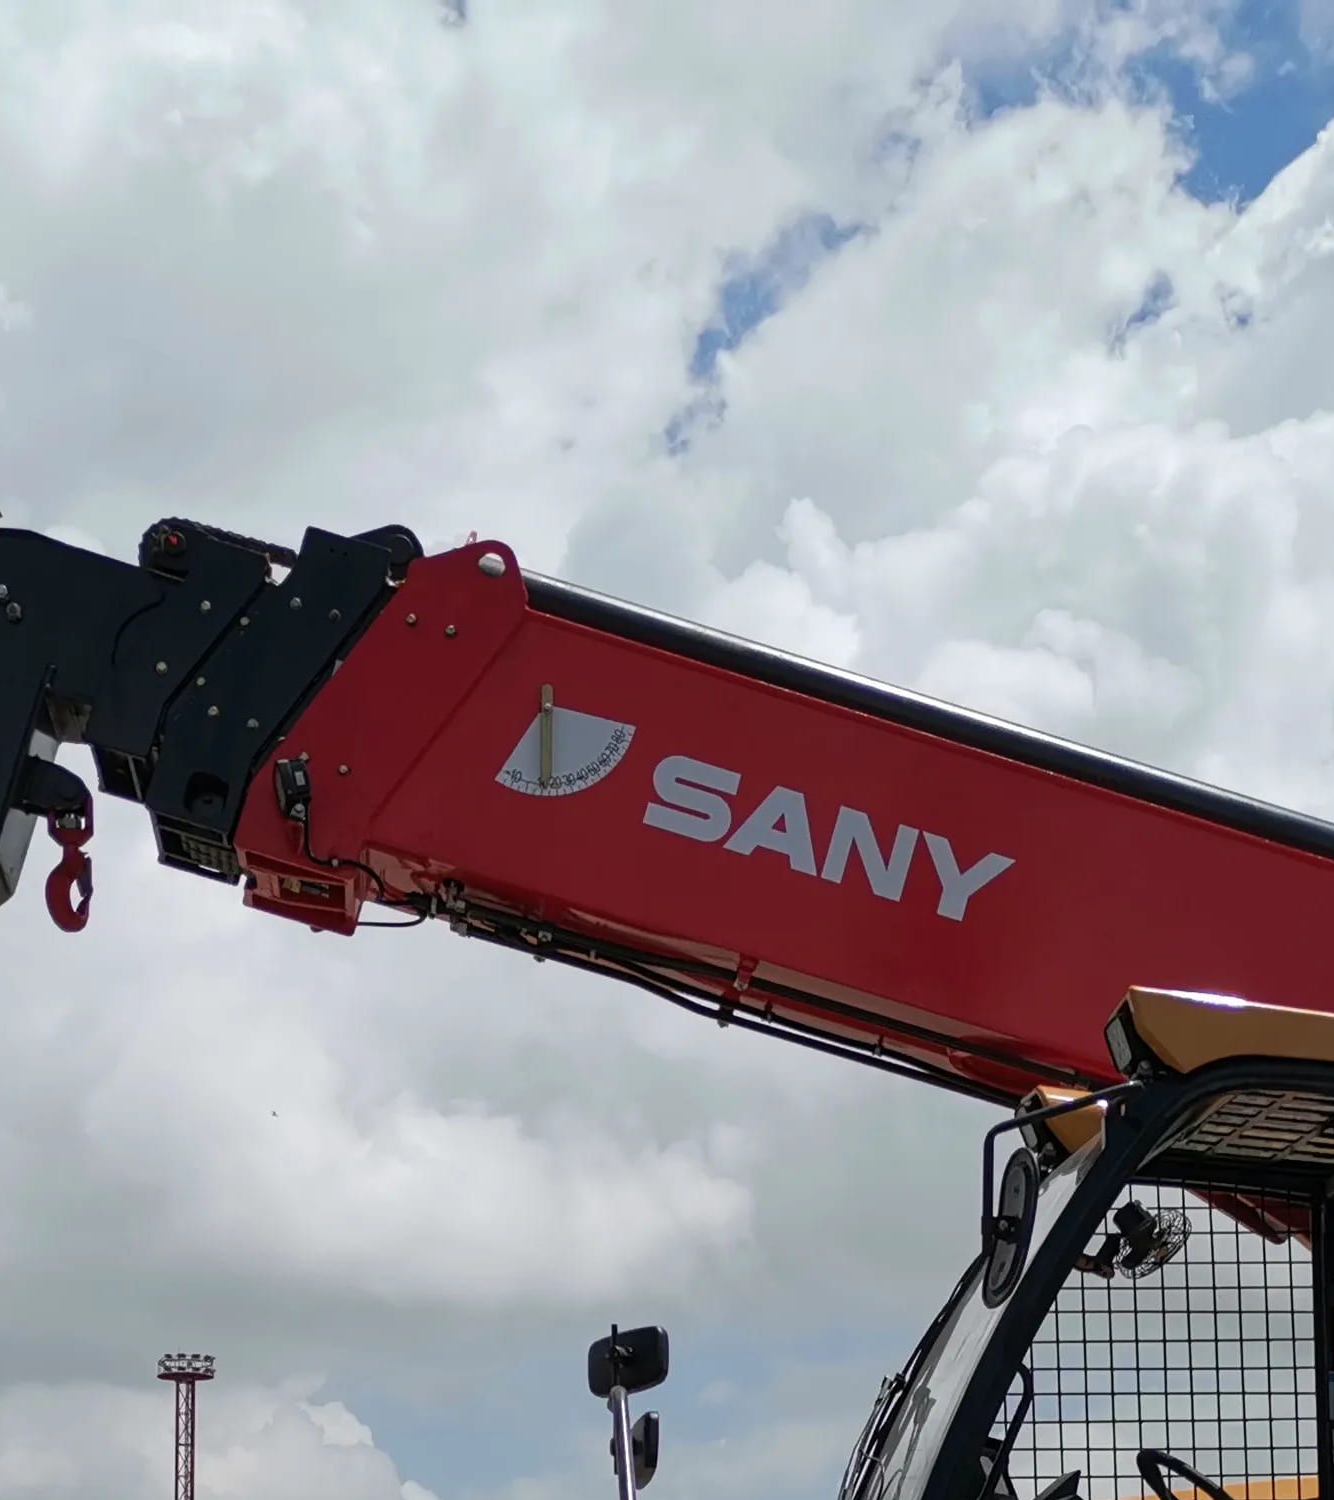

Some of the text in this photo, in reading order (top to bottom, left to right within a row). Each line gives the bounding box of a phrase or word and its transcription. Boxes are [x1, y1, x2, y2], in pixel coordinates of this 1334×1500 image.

[562, 773, 576, 786] 30
[576, 768, 589, 781] 40
[642, 754, 1017, 922] SANY
